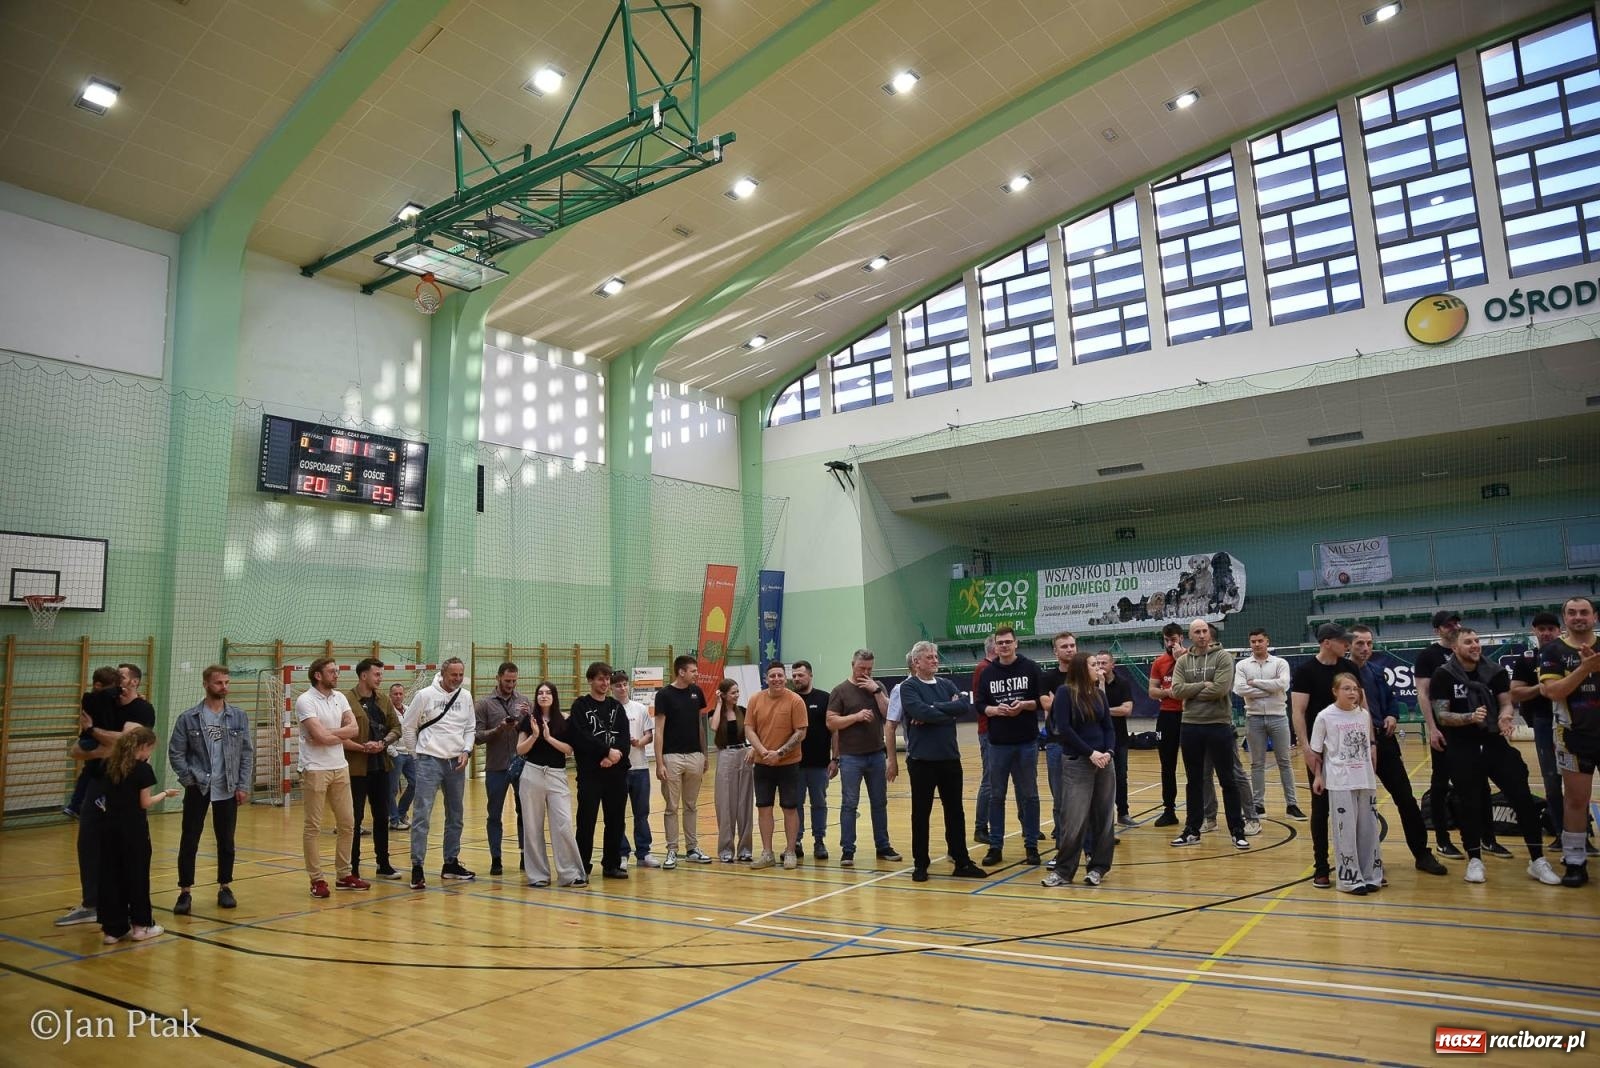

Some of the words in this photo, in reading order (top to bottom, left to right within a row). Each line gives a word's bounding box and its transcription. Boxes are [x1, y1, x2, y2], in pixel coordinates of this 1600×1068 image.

[1485, 277, 1600, 321] OŚROD
[300, 460, 342, 474] GOSPODARZE
[363, 468, 386, 481] GOŚCIE
[303, 475, 326, 493] 20
[372, 485, 393, 502] 25
[1327, 540, 1380, 554] MIESZKO
[1044, 564, 1101, 583] WSZYSTKO
[1105, 561, 1126, 577] DLA
[1130, 556, 1182, 575] TWOJEGO
[984, 579, 1029, 598] ZOO
[1045, 579, 1111, 598] DOMOWEGO
[1115, 576, 1138, 592] ZOO
[980, 595, 1028, 612] MAR
[990, 680, 1005, 694] BIG
[1006, 676, 1029, 692] STAR
